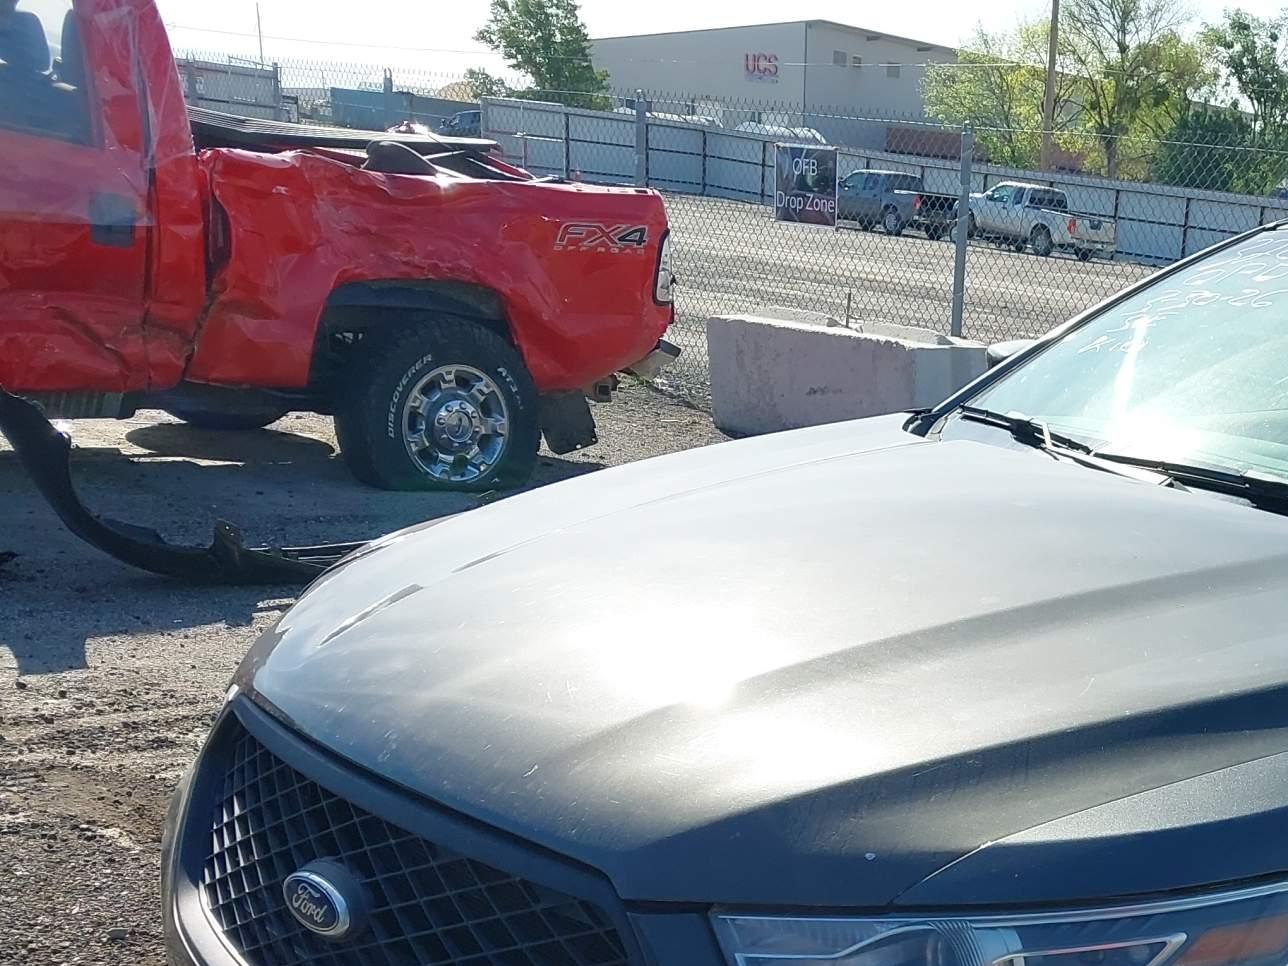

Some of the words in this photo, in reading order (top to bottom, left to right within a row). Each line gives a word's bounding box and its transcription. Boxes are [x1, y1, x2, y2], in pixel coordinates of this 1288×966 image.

[745, 53, 779, 76] UCS
[793, 157, 818, 176] OFB
[776, 190, 804, 213] Drop
[805, 193, 835, 213] Zone
[555, 221, 649, 249] FX4
[387, 353, 433, 439] DISCOVERER
[292, 882, 328, 924] Ford
